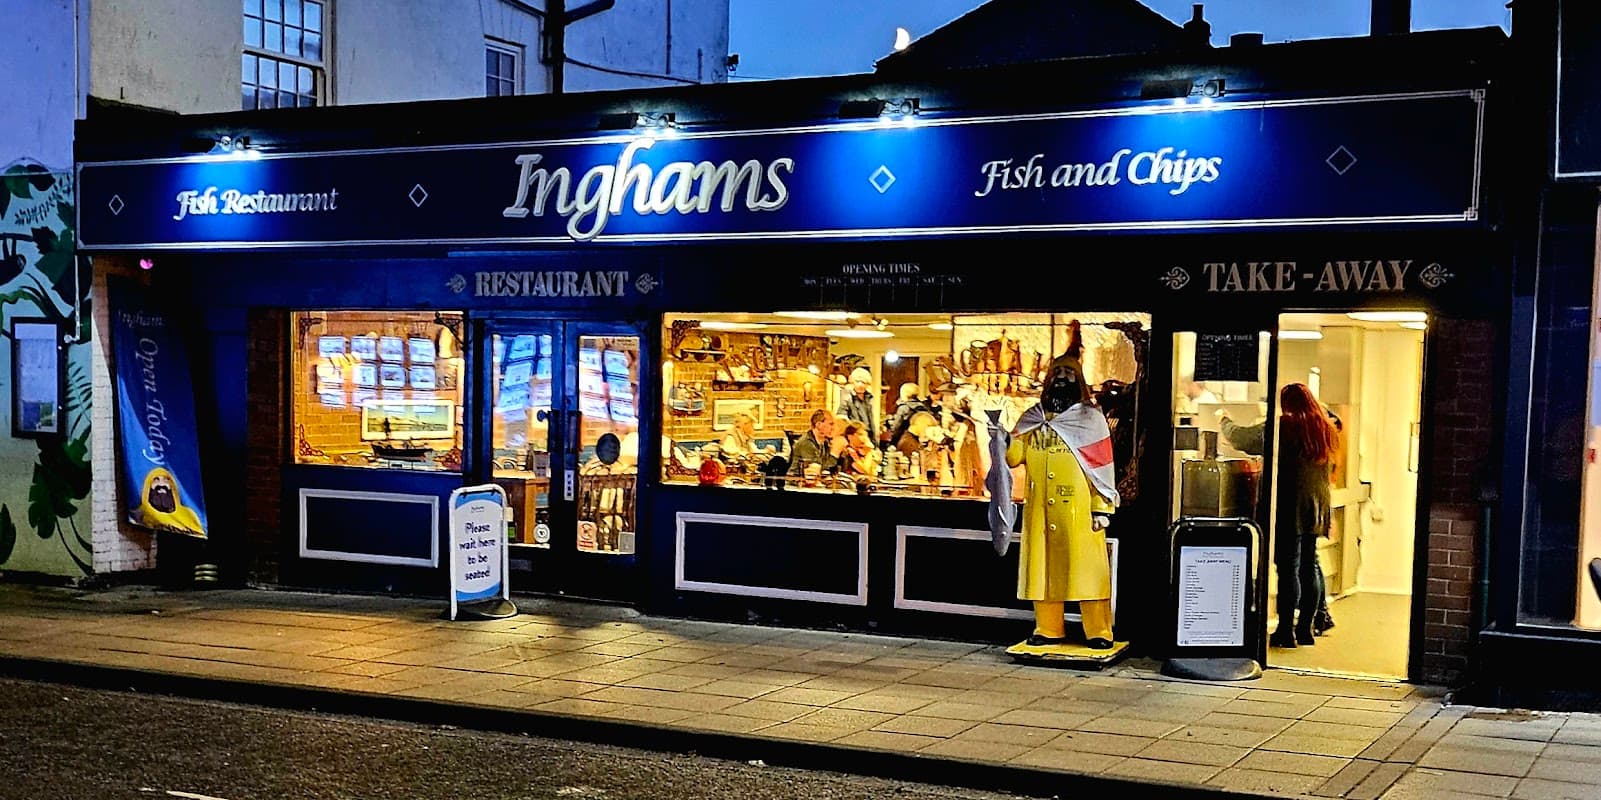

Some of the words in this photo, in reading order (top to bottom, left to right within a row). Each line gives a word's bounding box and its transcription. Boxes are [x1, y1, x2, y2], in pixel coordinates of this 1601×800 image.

[974, 153, 1046, 197] Fish
[1051, 149, 1132, 188] and
[1127, 147, 1222, 195] Chips
[173, 186, 219, 220] Fish
[221, 185, 339, 216] Restaurant
[503, 137, 793, 241] Inghams
[842, 264, 886, 274] OPENING
[888, 263, 920, 274] TIMES
[474, 271, 629, 298] RESTAURANT
[135, 337, 159, 392] Open
[142, 398, 171, 465] Today
[465, 522, 491, 533] Please
[459, 538, 477, 549] wait
[478, 536, 496, 547] here
[468, 556, 476, 565] to
[478, 552, 488, 563] be
[465, 566, 490, 580] seated
